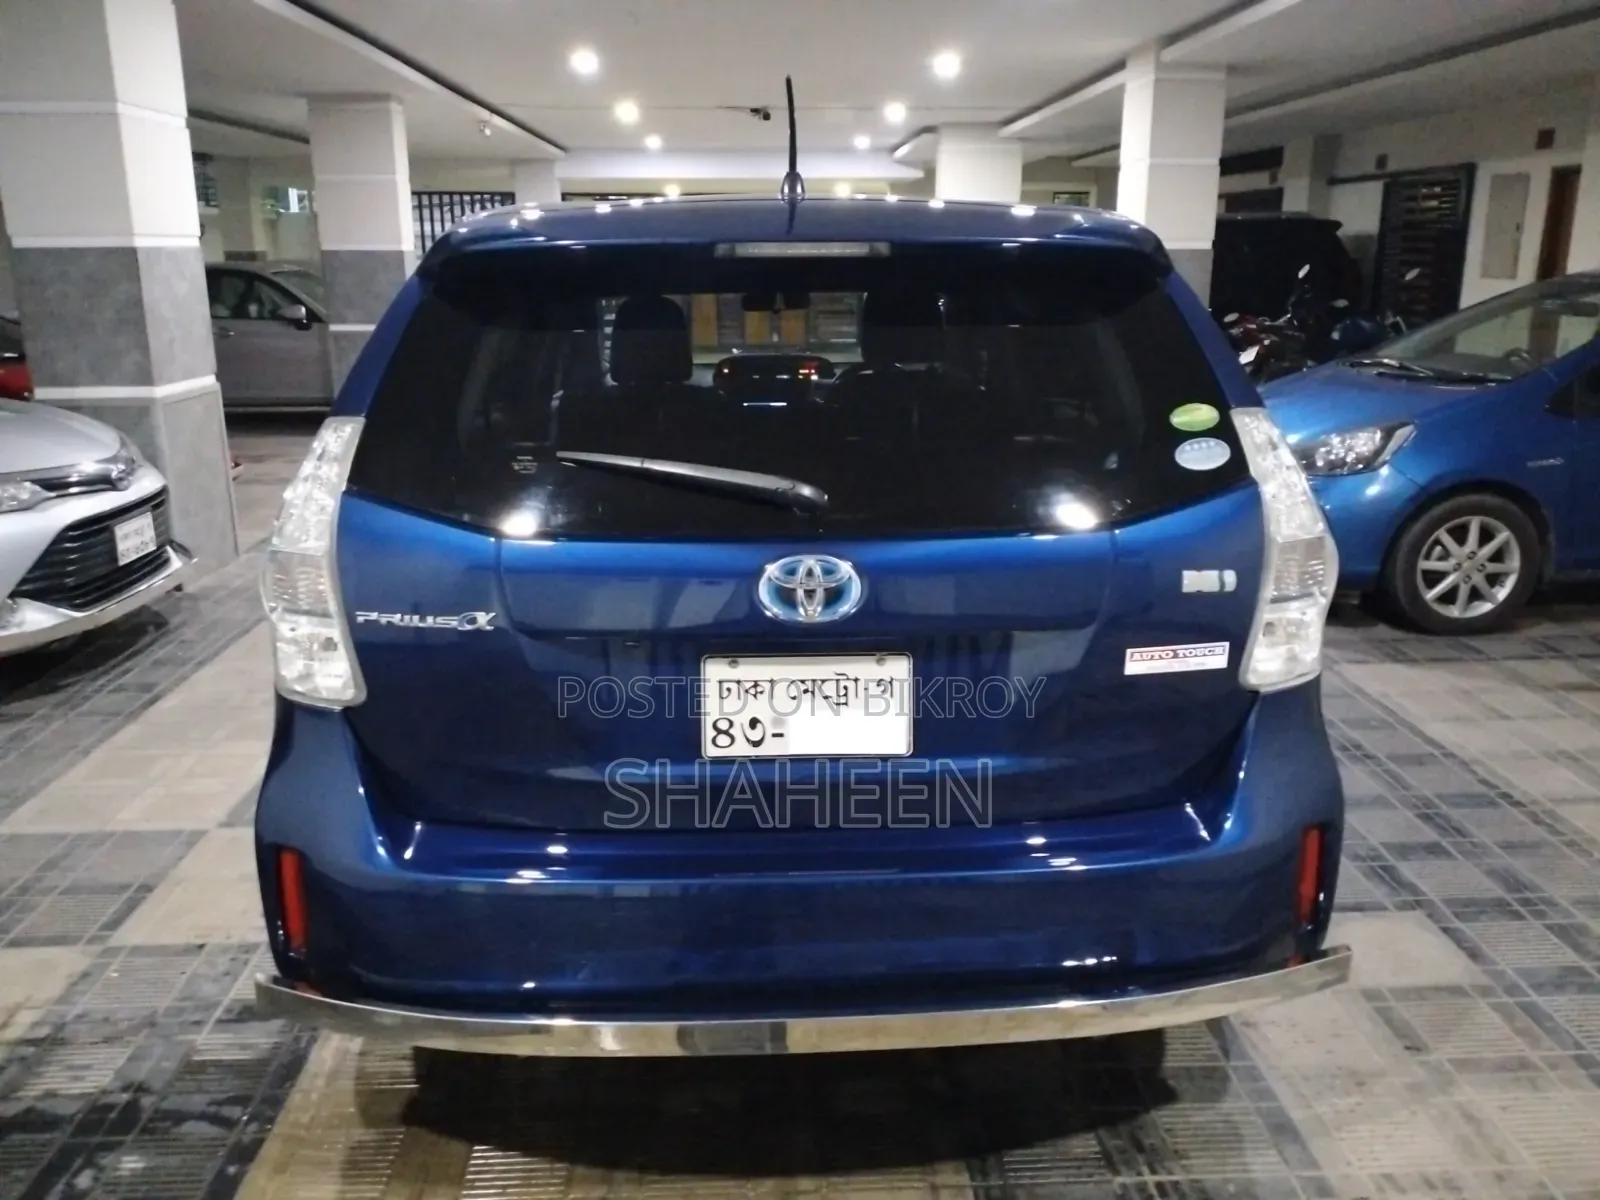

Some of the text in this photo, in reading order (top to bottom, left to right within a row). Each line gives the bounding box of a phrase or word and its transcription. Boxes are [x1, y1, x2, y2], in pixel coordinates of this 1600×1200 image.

[1131, 646, 1225, 661] AUTO TOUCH
[717, 678, 775, 700] ঢাকা
